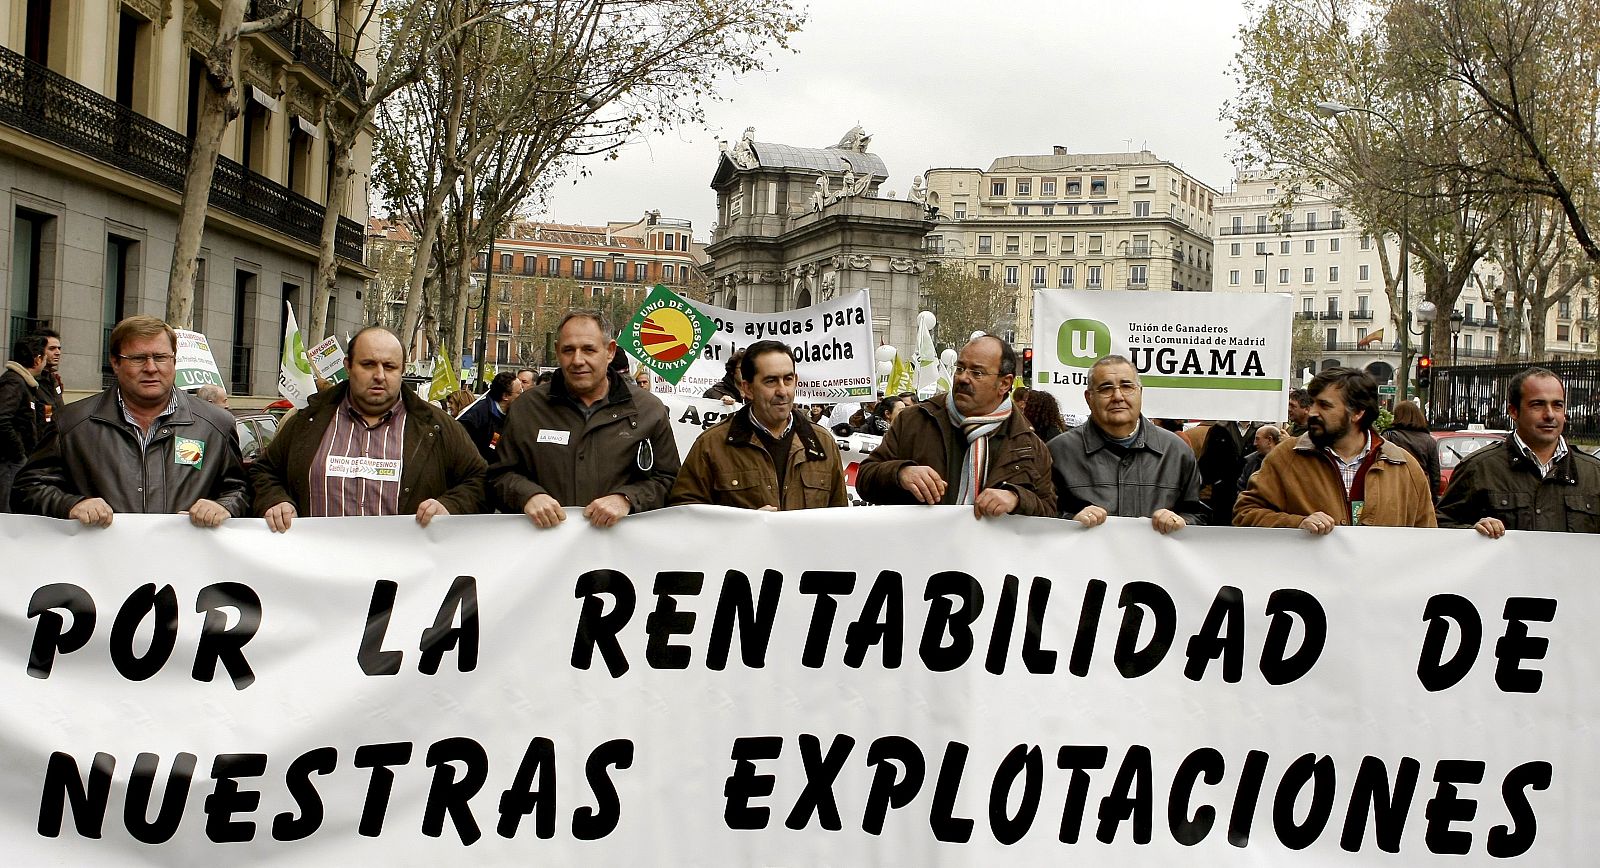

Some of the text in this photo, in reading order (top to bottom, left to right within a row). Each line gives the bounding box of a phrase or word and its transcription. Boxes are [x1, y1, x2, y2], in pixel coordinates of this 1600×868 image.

[640, 299, 702, 356] UNIÓ DE PAGESOS
[706, 306, 866, 339] os ayudas para
[1129, 323, 1229, 333] Unión de Ganaderos
[632, 322, 688, 370] DE CATALUNYA
[794, 337, 854, 363] olacha
[1128, 335, 1266, 346] de la Comunidad de Madrid
[1129, 347, 1266, 376] UGAMA
[182, 370, 218, 386] UCCL
[279, 372, 300, 399] nión
[326, 374, 344, 385] CL
[811, 380, 821, 388] DE
[822, 376, 871, 387] CAMPESINOS
[1053, 371, 1070, 384] La
[360, 460, 397, 468] CAMPESINOS
[27, 568, 1558, 694] POR LA RENTABILIDAD DE
[37, 733, 1553, 859] NUESTRAS EXPLOTACIONES
